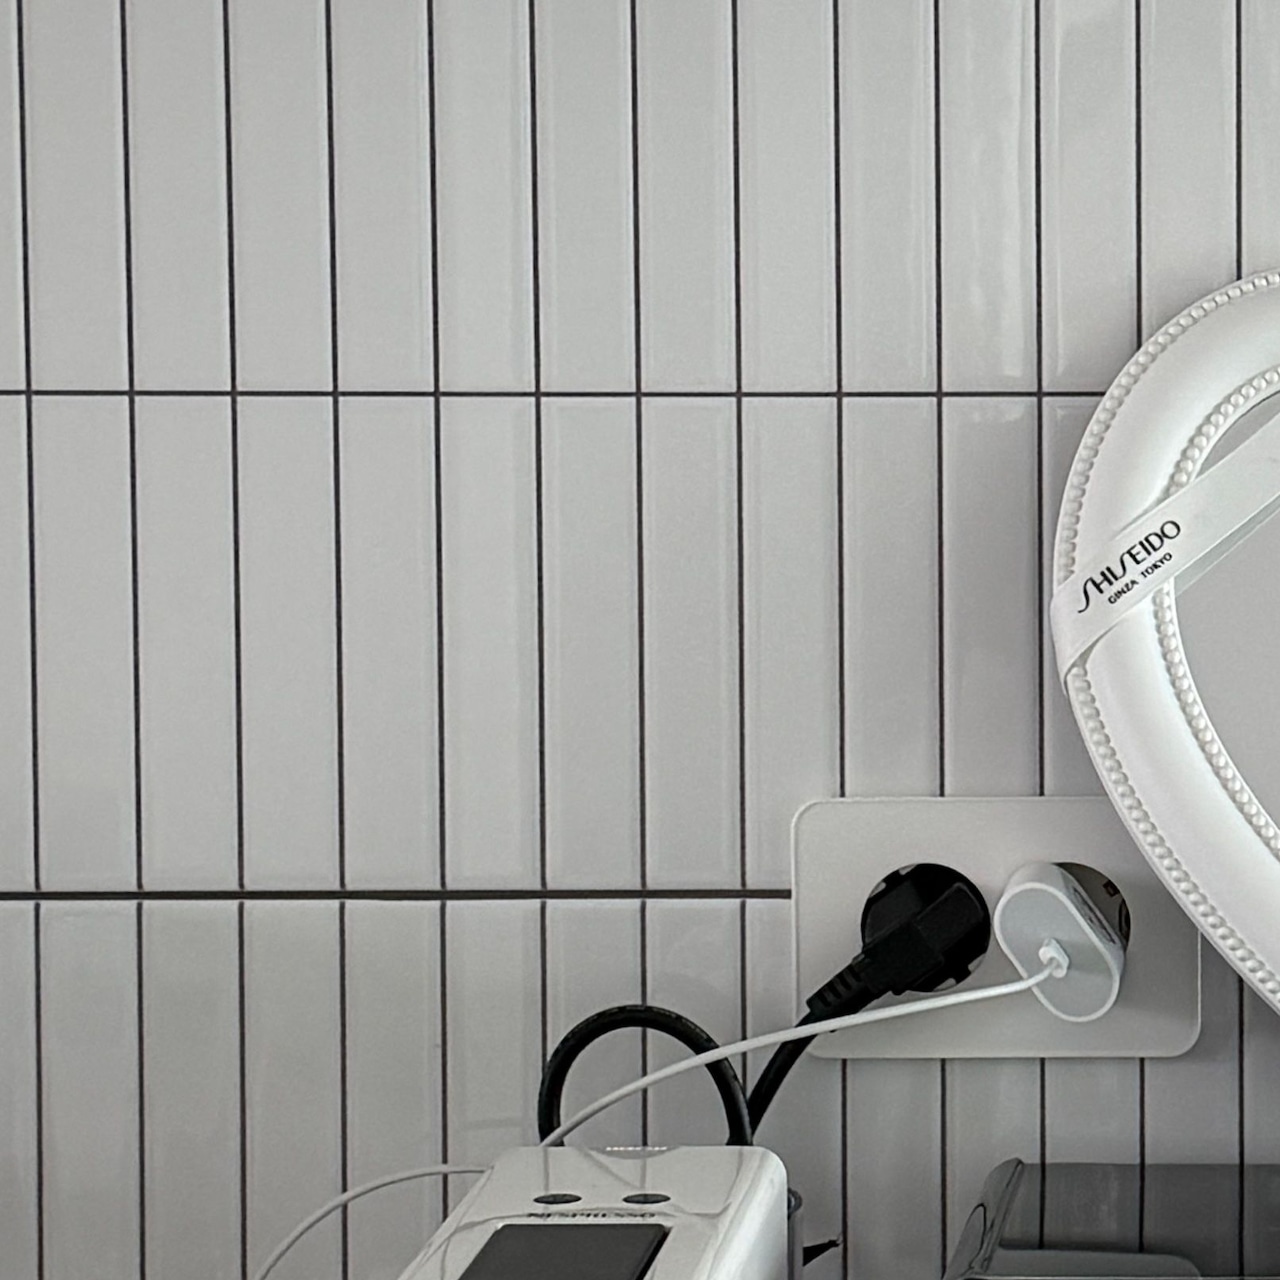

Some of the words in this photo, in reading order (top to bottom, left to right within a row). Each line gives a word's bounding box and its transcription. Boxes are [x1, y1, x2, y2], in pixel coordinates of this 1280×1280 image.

[1078, 520, 1181, 613] SHISEIDO
[1107, 579, 1139, 604] GINZA
[1140, 552, 1172, 578] TOKYO
